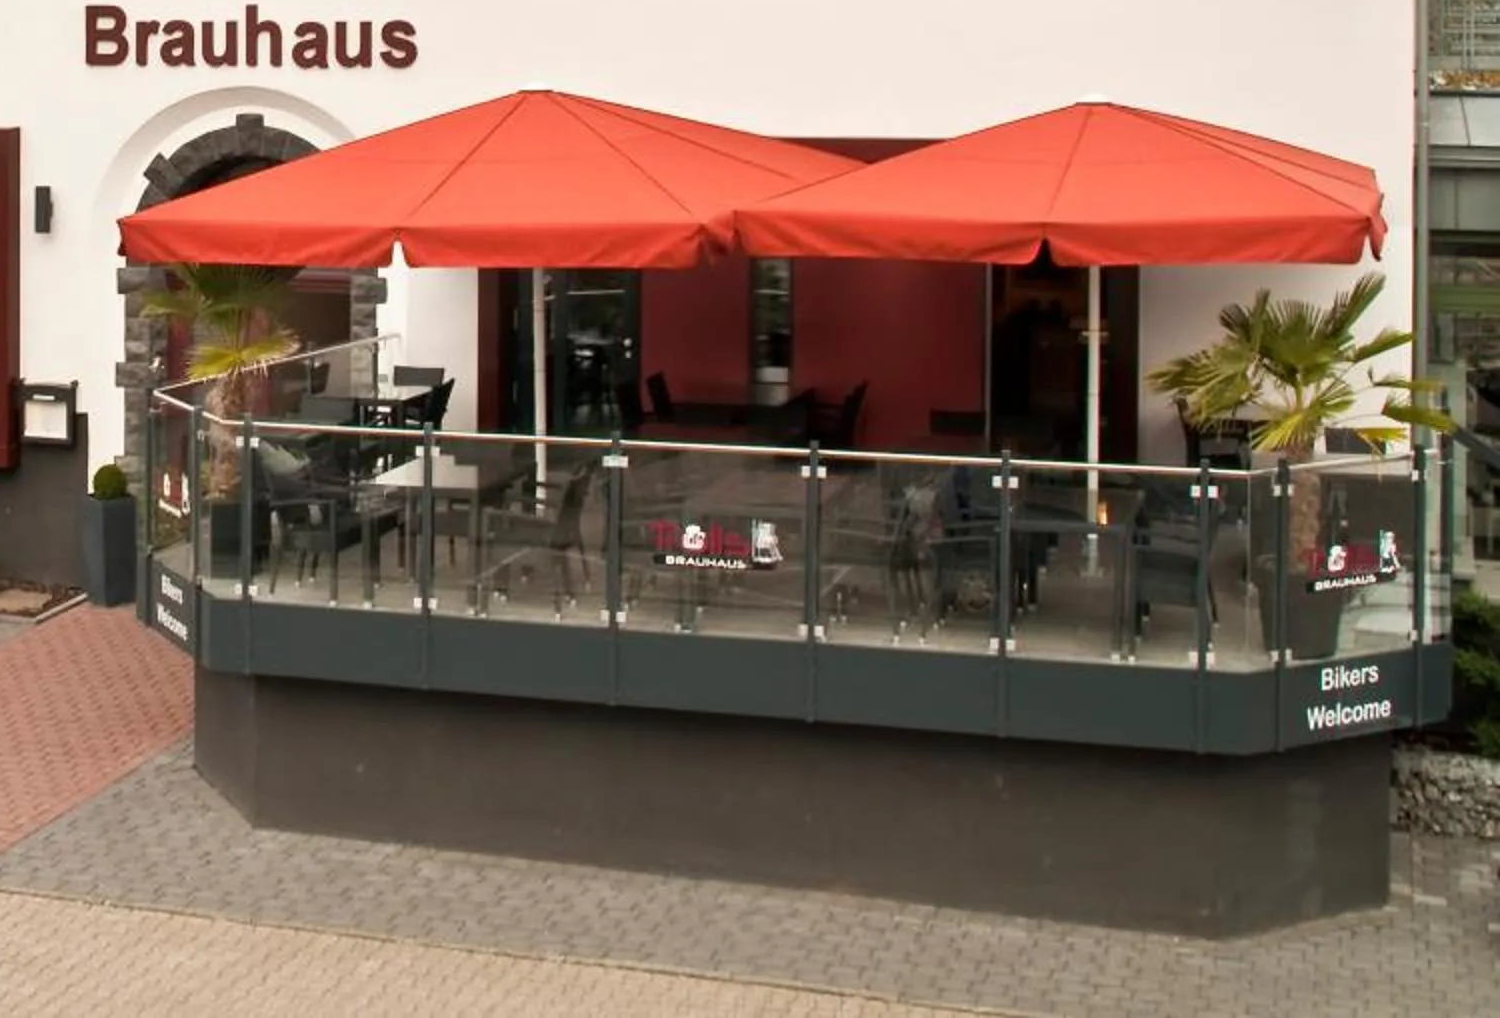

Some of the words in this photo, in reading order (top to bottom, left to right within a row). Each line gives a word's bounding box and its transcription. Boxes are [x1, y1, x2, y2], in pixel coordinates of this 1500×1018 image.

[85, 4, 418, 69] Brauhaus
[665, 555, 748, 569] BRAUHAUS
[1321, 664, 1379, 691] Bikers
[1307, 699, 1392, 730] Welcome
